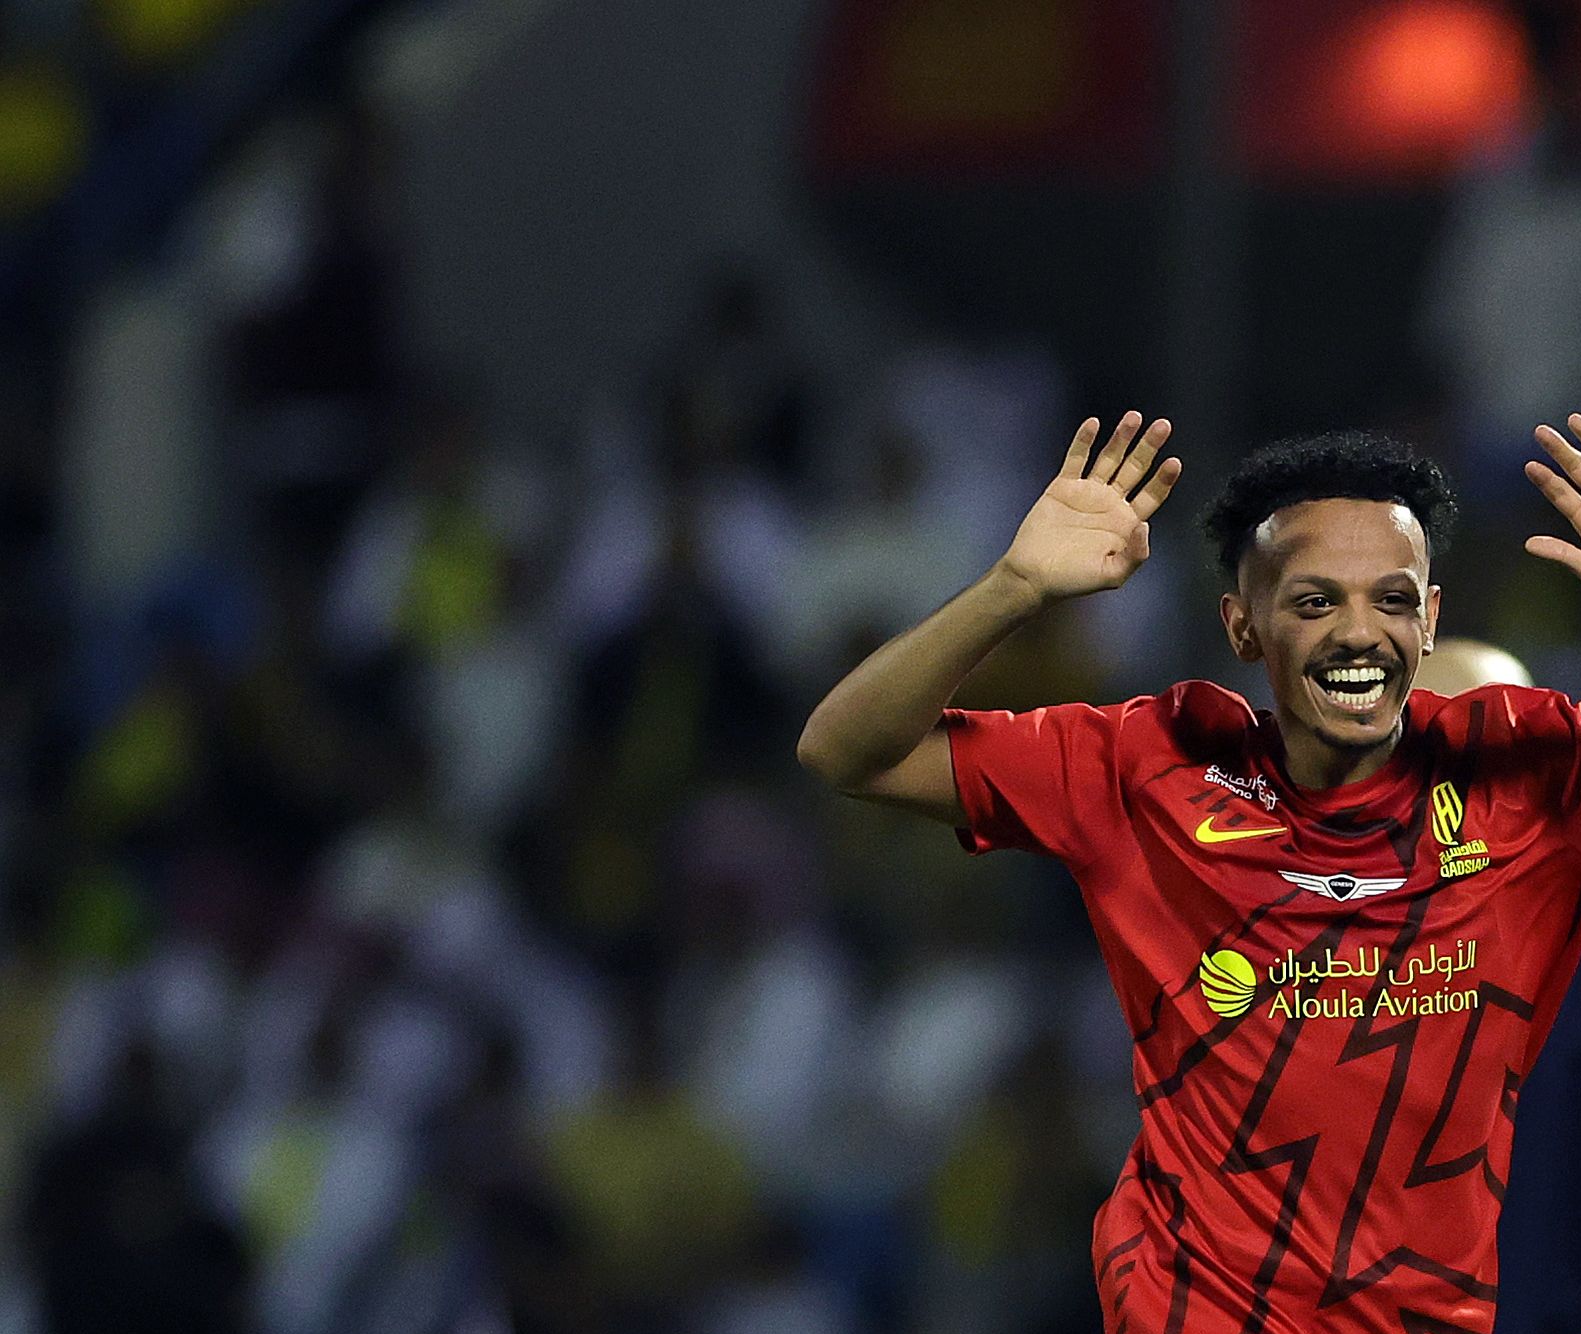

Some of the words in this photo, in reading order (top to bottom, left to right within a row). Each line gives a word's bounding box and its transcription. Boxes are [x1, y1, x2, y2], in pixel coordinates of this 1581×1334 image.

[1268, 947, 1380, 988] للطيران
[1388, 940, 1477, 986] الأولى
[1268, 989, 1365, 1019] Aloula
[1372, 986, 1479, 1017] Aviation
